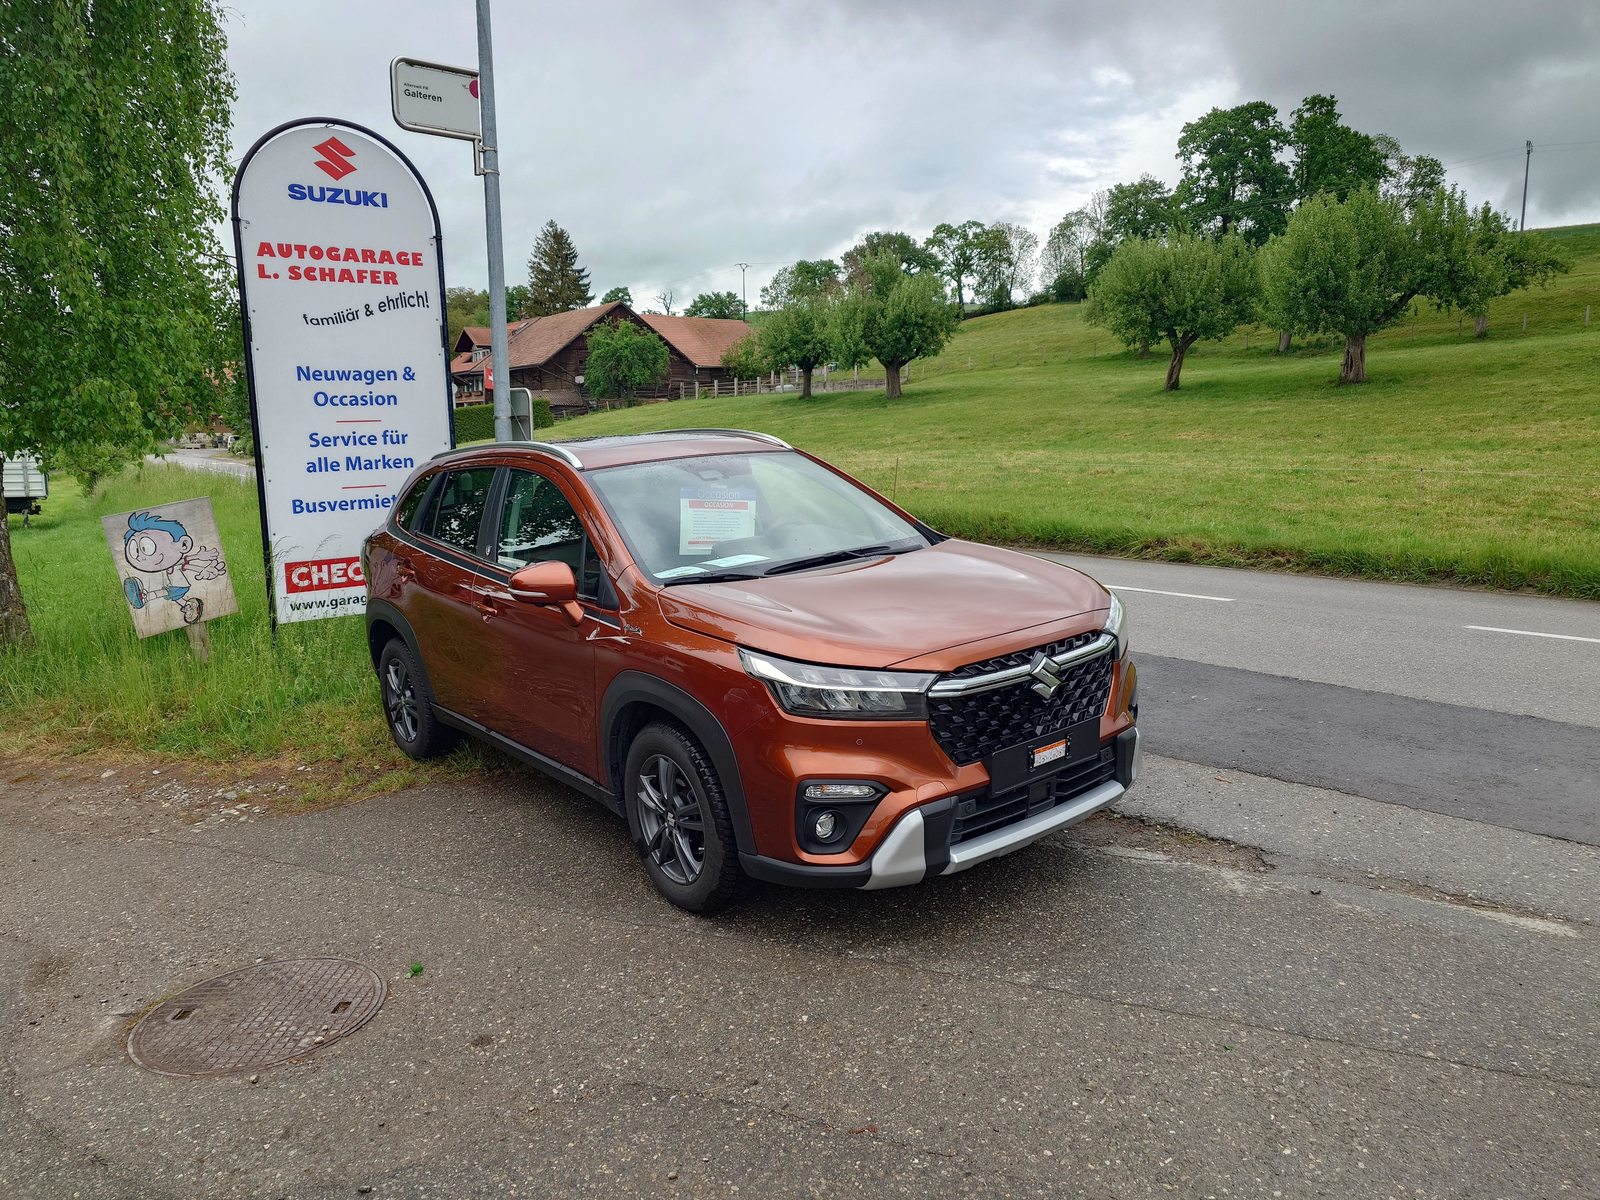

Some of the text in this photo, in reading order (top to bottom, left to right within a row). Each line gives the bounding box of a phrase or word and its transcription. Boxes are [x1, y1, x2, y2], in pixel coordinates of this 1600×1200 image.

[287, 183, 389, 208] SUZUKI
[256, 241, 424, 267] AUTOGARAGE
[257, 264, 399, 286] L. SCHAFER
[302, 290, 430, 326] familiär & ehrlich!
[296, 365, 416, 386] Neuwagen &
[313, 391, 398, 407] Occasion
[308, 430, 408, 448] Service für
[306, 454, 414, 473] alle Marken
